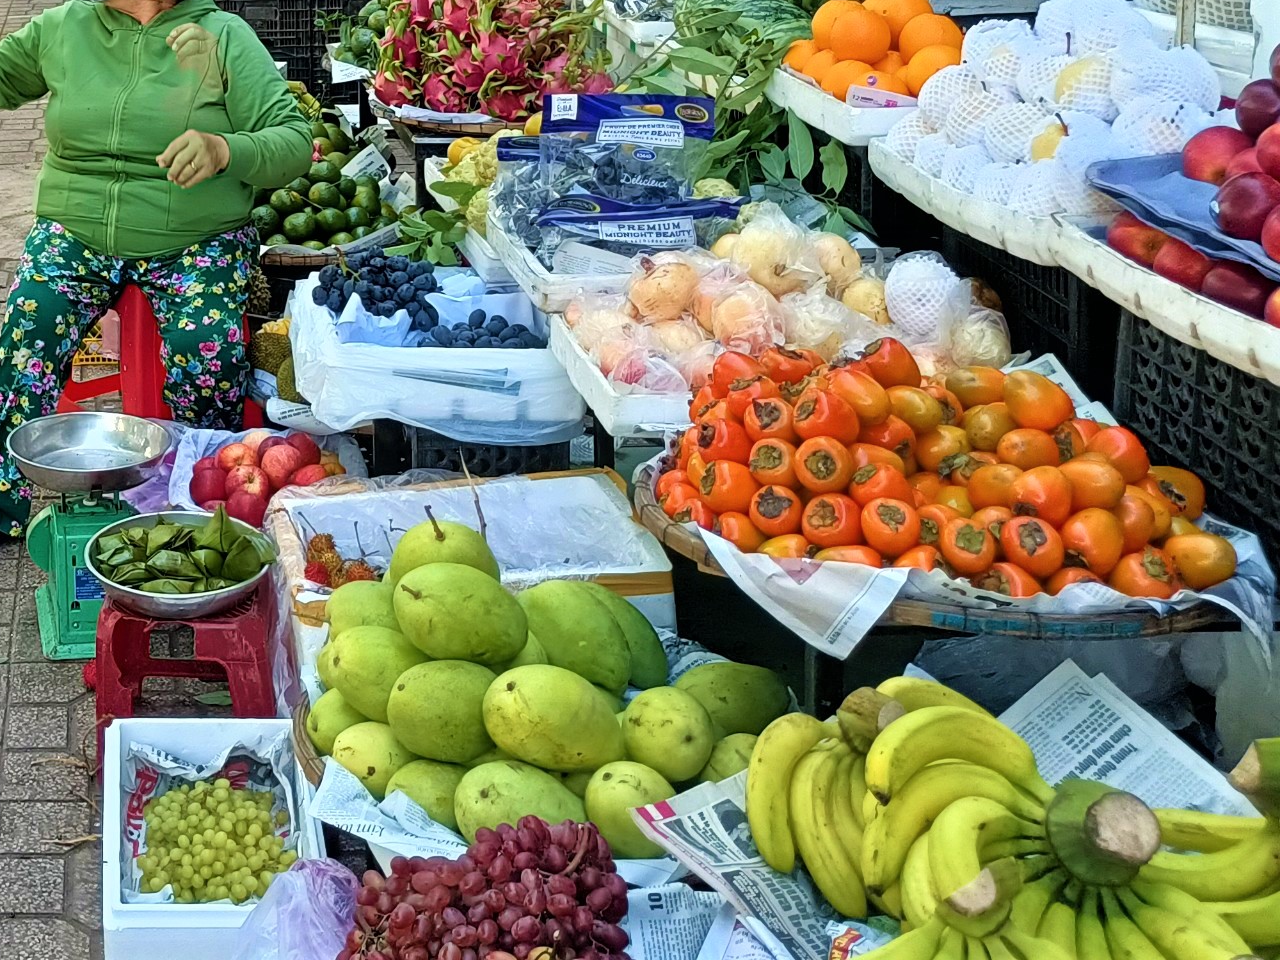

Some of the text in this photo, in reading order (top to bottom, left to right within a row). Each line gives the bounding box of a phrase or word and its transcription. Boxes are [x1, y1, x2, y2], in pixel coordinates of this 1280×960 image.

[651, 130, 682, 138] BEAUTY
[620, 172, 668, 188] Délicieux
[617, 222, 681, 232] PREMIUM
[655, 229, 693, 239] BEAUTY
